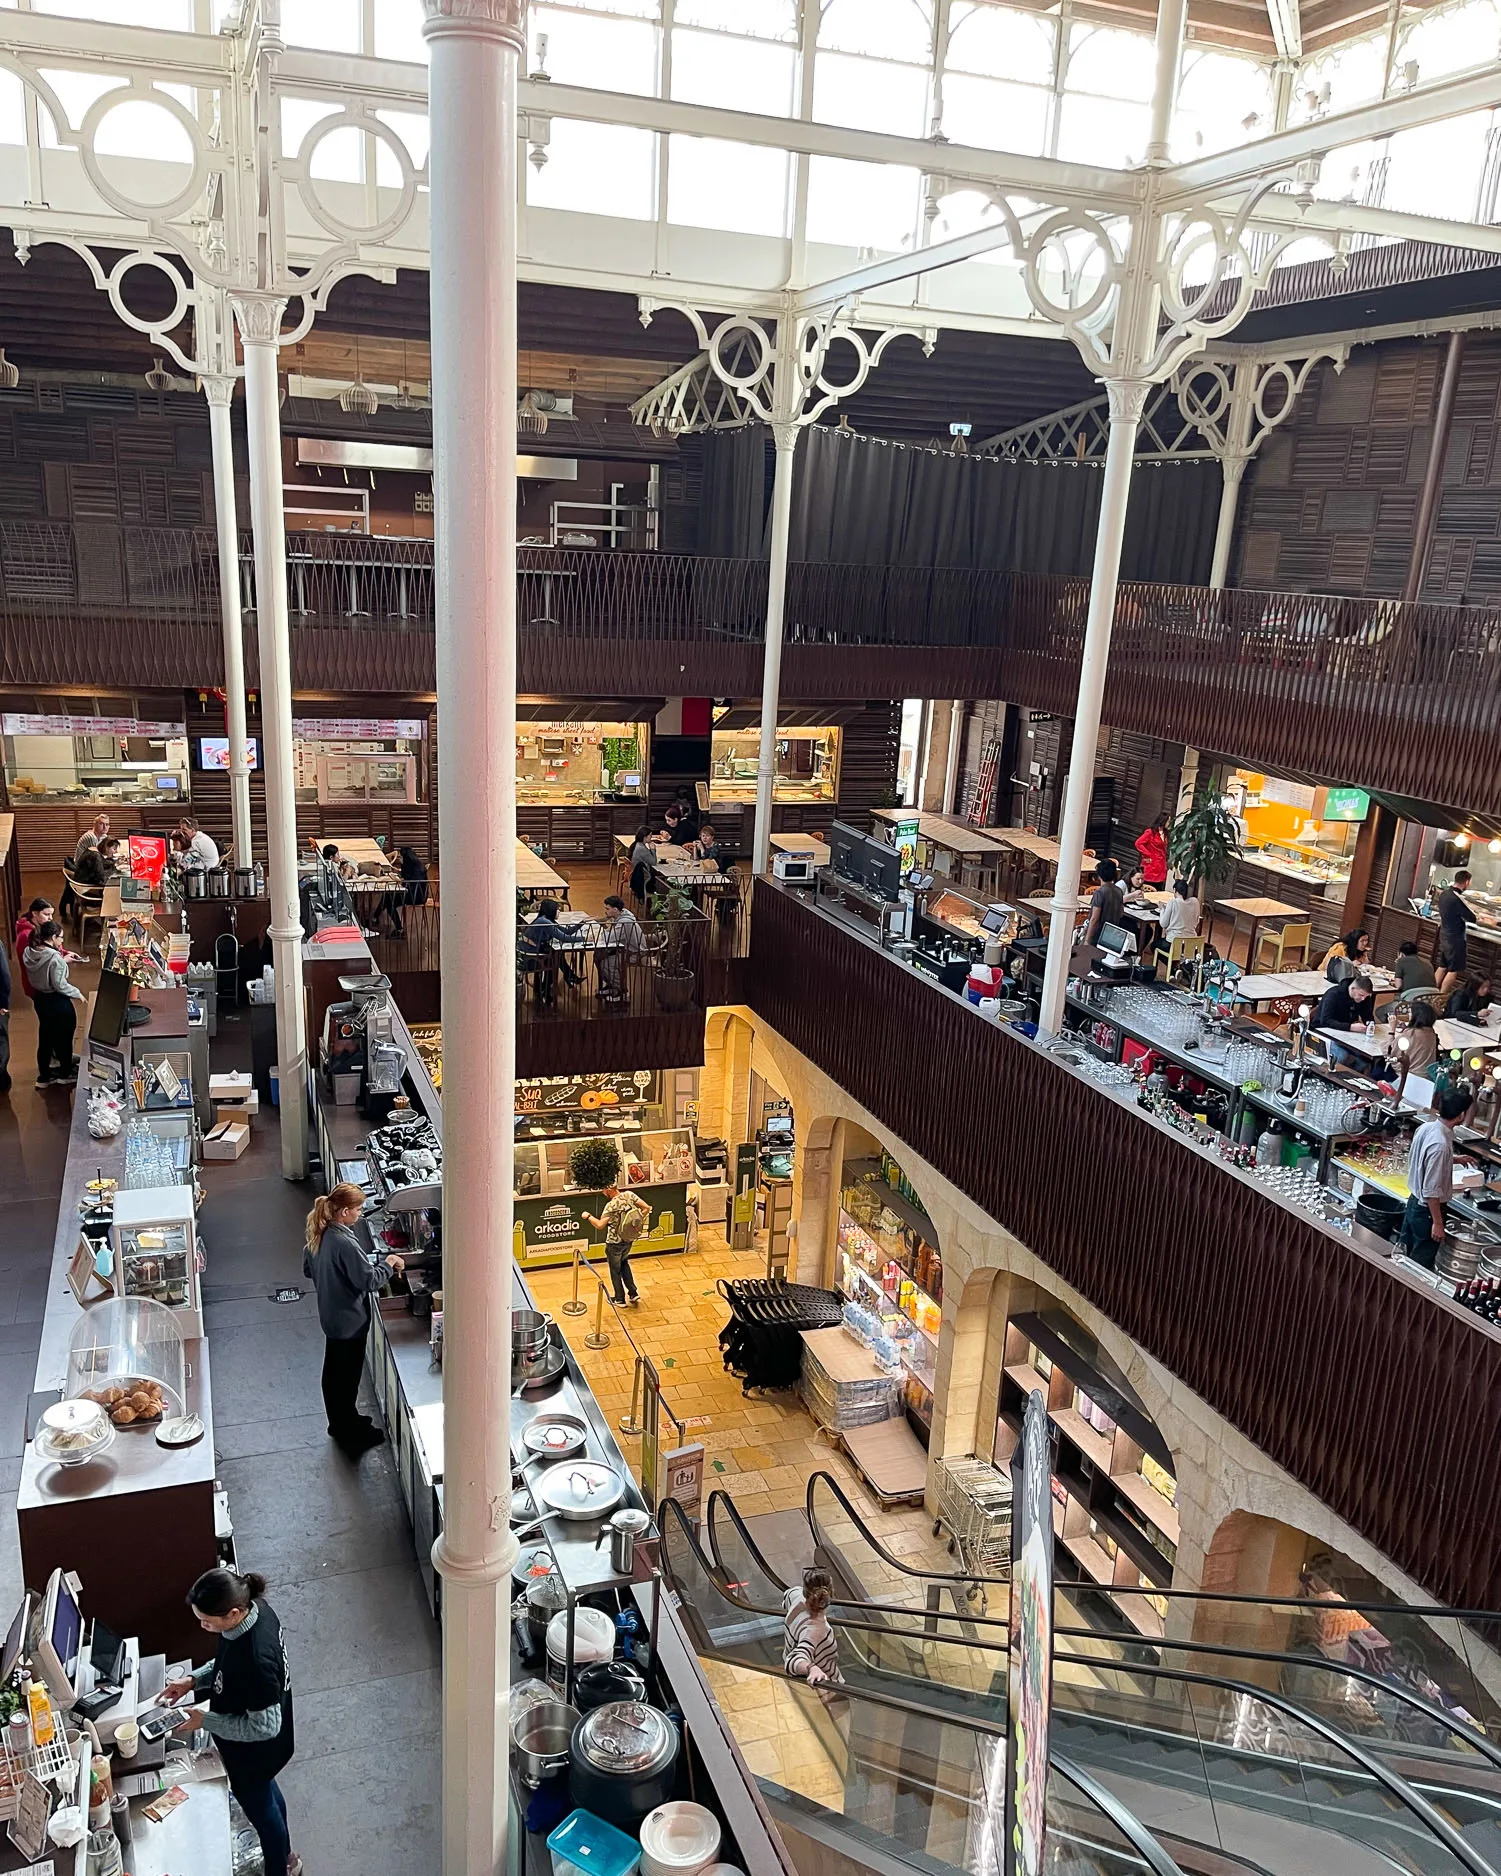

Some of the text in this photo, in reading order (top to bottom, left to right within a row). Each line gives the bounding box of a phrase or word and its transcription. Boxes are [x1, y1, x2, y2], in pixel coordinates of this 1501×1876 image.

[537, 726, 560, 734] maltese
[579, 726, 596, 735] food
[534, 1220, 580, 1234] arkadia
[538, 1231, 576, 1239] FOODSTORE
